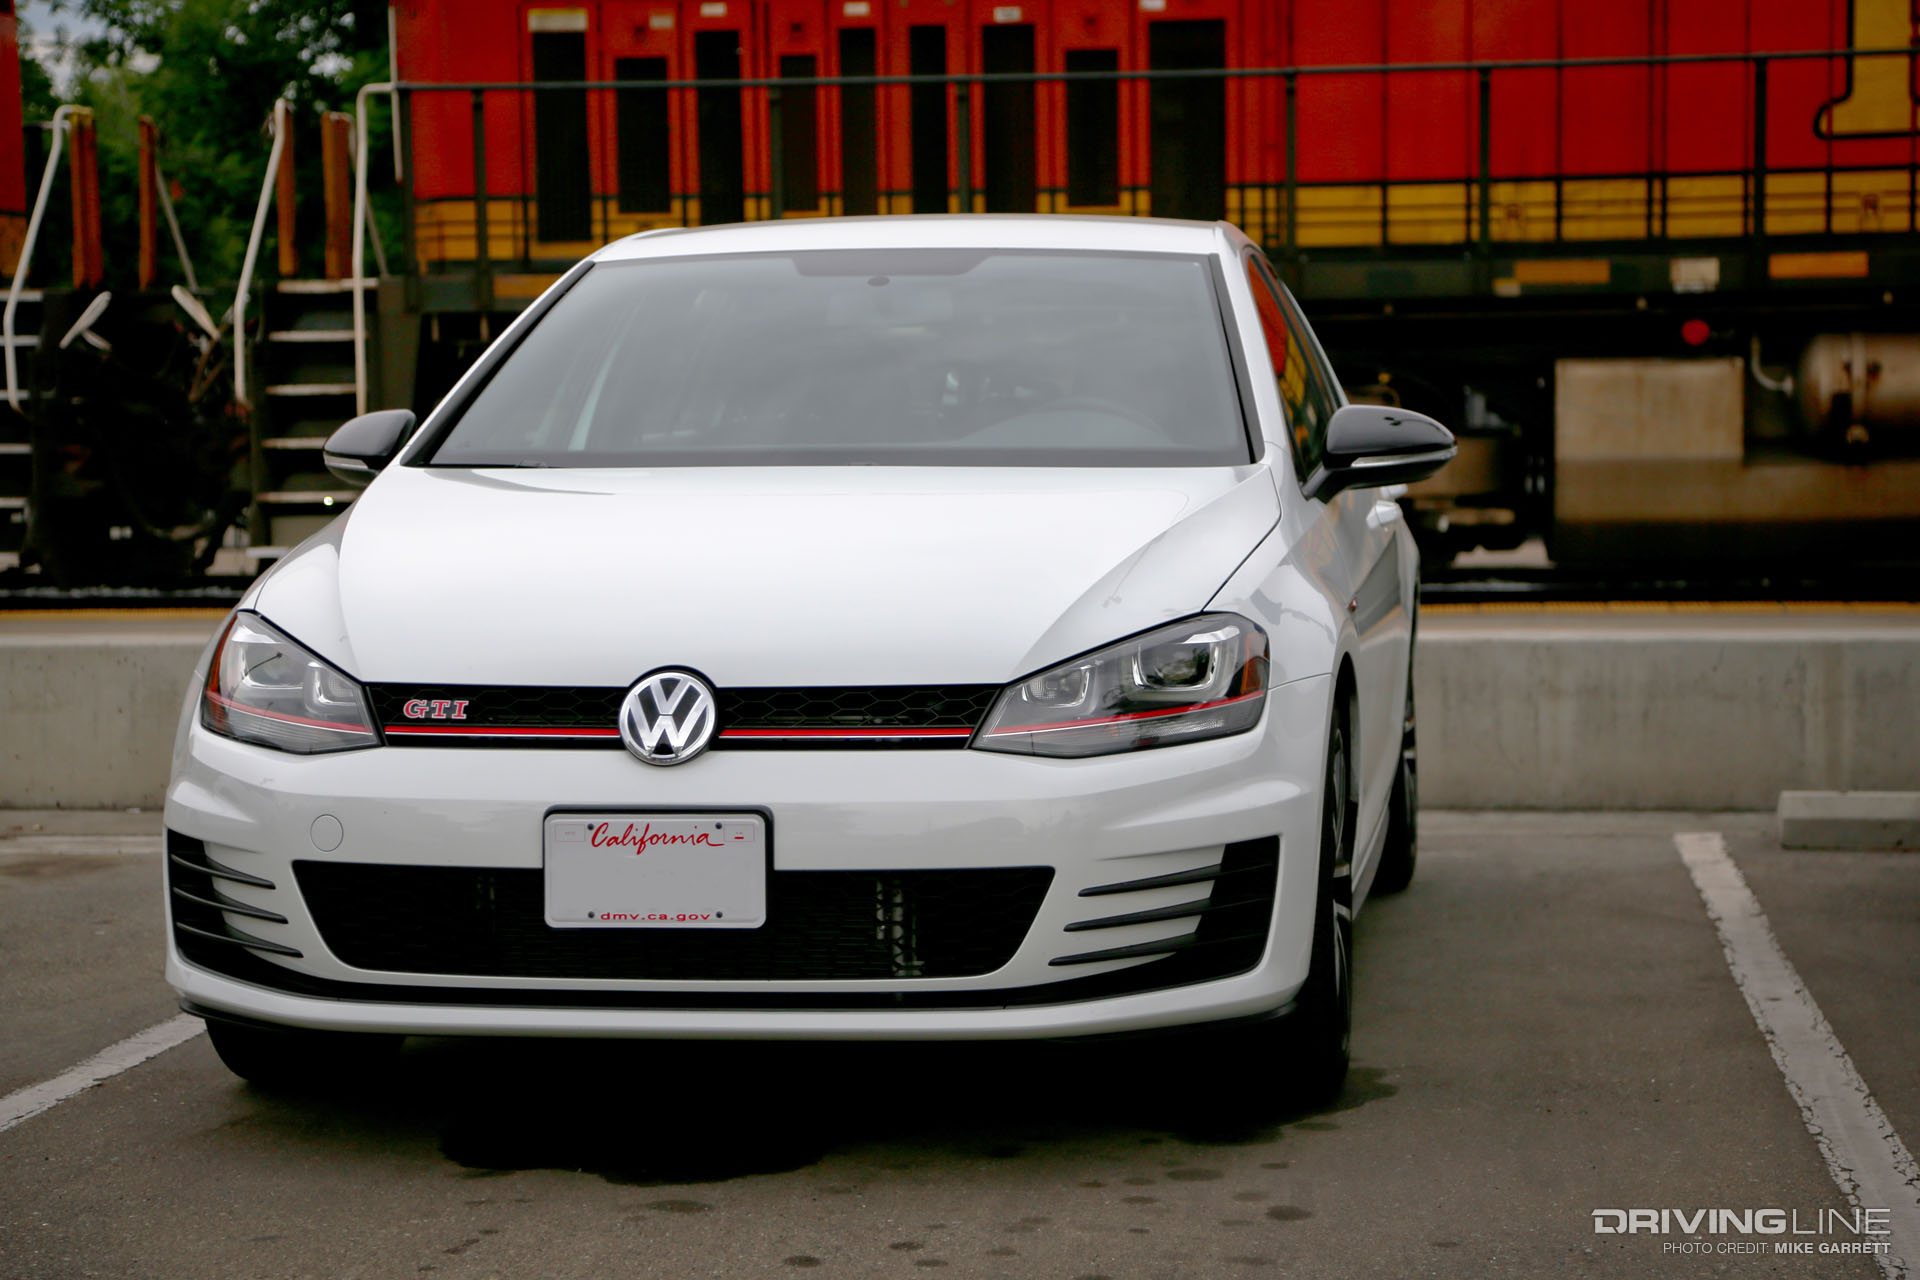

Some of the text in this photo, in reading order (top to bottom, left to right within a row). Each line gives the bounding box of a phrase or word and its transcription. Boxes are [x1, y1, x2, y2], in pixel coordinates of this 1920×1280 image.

[403, 699, 469, 719] GTI
[591, 821, 725, 856] California
[600, 911, 712, 922] dmv.ca.gov
